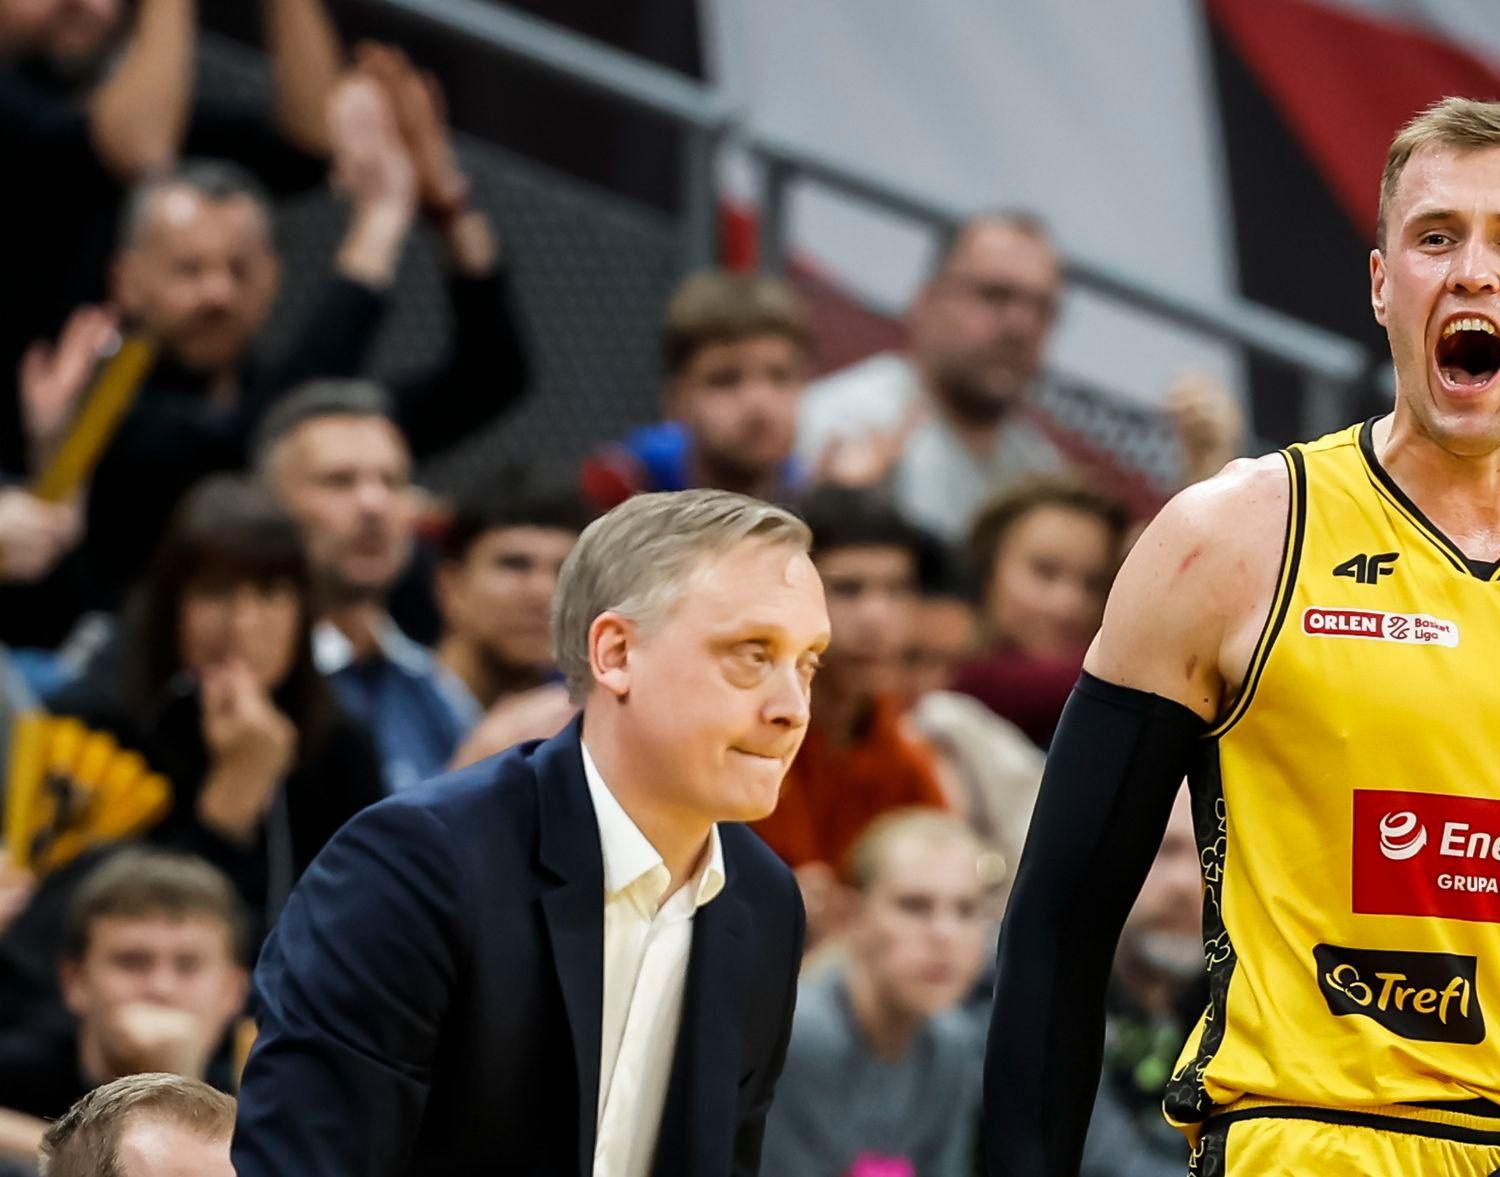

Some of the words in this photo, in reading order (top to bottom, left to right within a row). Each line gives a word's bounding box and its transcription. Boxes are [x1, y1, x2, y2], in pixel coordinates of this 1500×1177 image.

[1332, 552, 1400, 585] 4F
[1309, 613, 1376, 632] ORLEN
[1415, 618, 1450, 632] Basket
[1415, 630, 1439, 641] Liga
[1437, 873, 1498, 893] GRUPA
[1375, 972, 1470, 1024] Trefl
